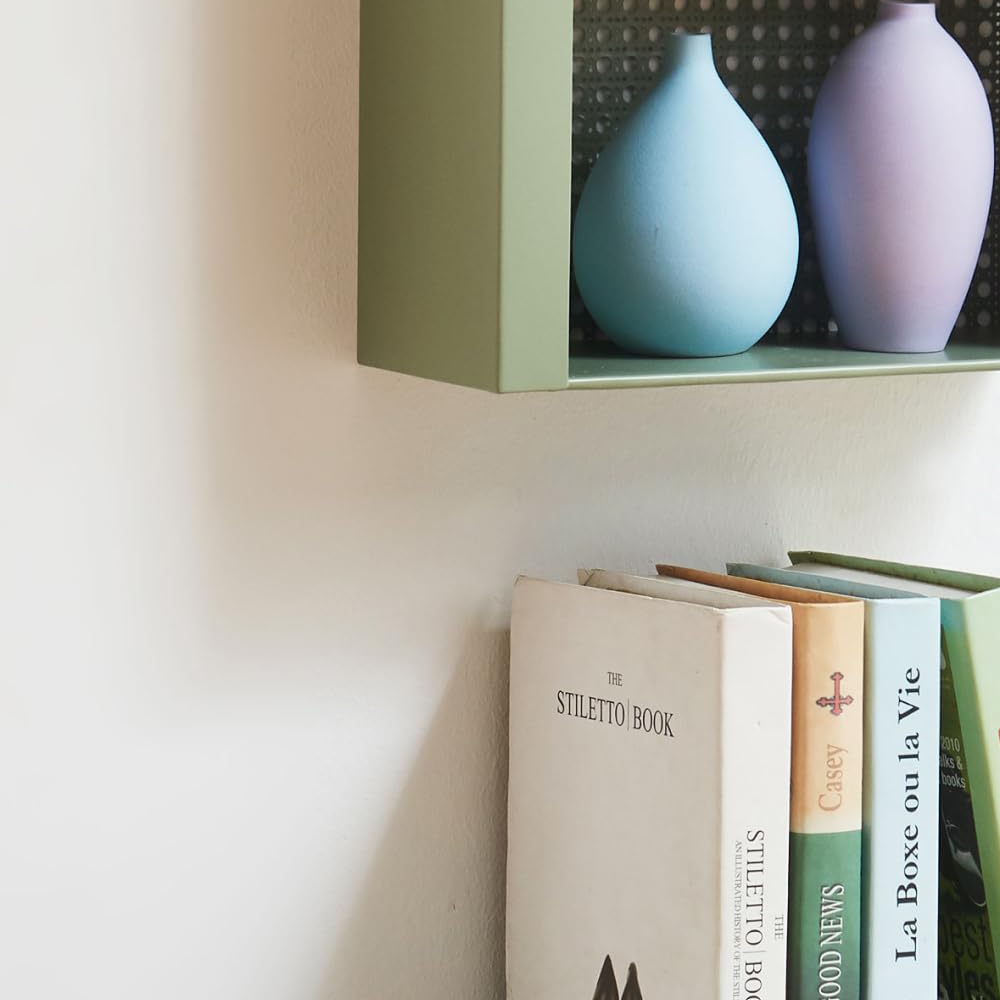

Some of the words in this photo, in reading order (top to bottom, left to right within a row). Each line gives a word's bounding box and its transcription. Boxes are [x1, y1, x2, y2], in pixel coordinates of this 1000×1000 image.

[607, 671, 623, 687] THE
[897, 667, 921, 725] Vie
[557, 690, 625, 727] STILETTO
[633, 705, 674, 738] BOOK
[898, 731, 919, 761] la
[819, 743, 849, 812] Casey
[903, 770, 919, 813] ou
[745, 830, 764, 946] STILETTO
[896, 824, 918, 906] Boxe
[774, 914, 784, 940] THE
[820, 884, 845, 947] NEWS
[895, 918, 917, 962] La
[744, 962, 762, 1000] BO
[819, 950, 842, 1000] OOD
